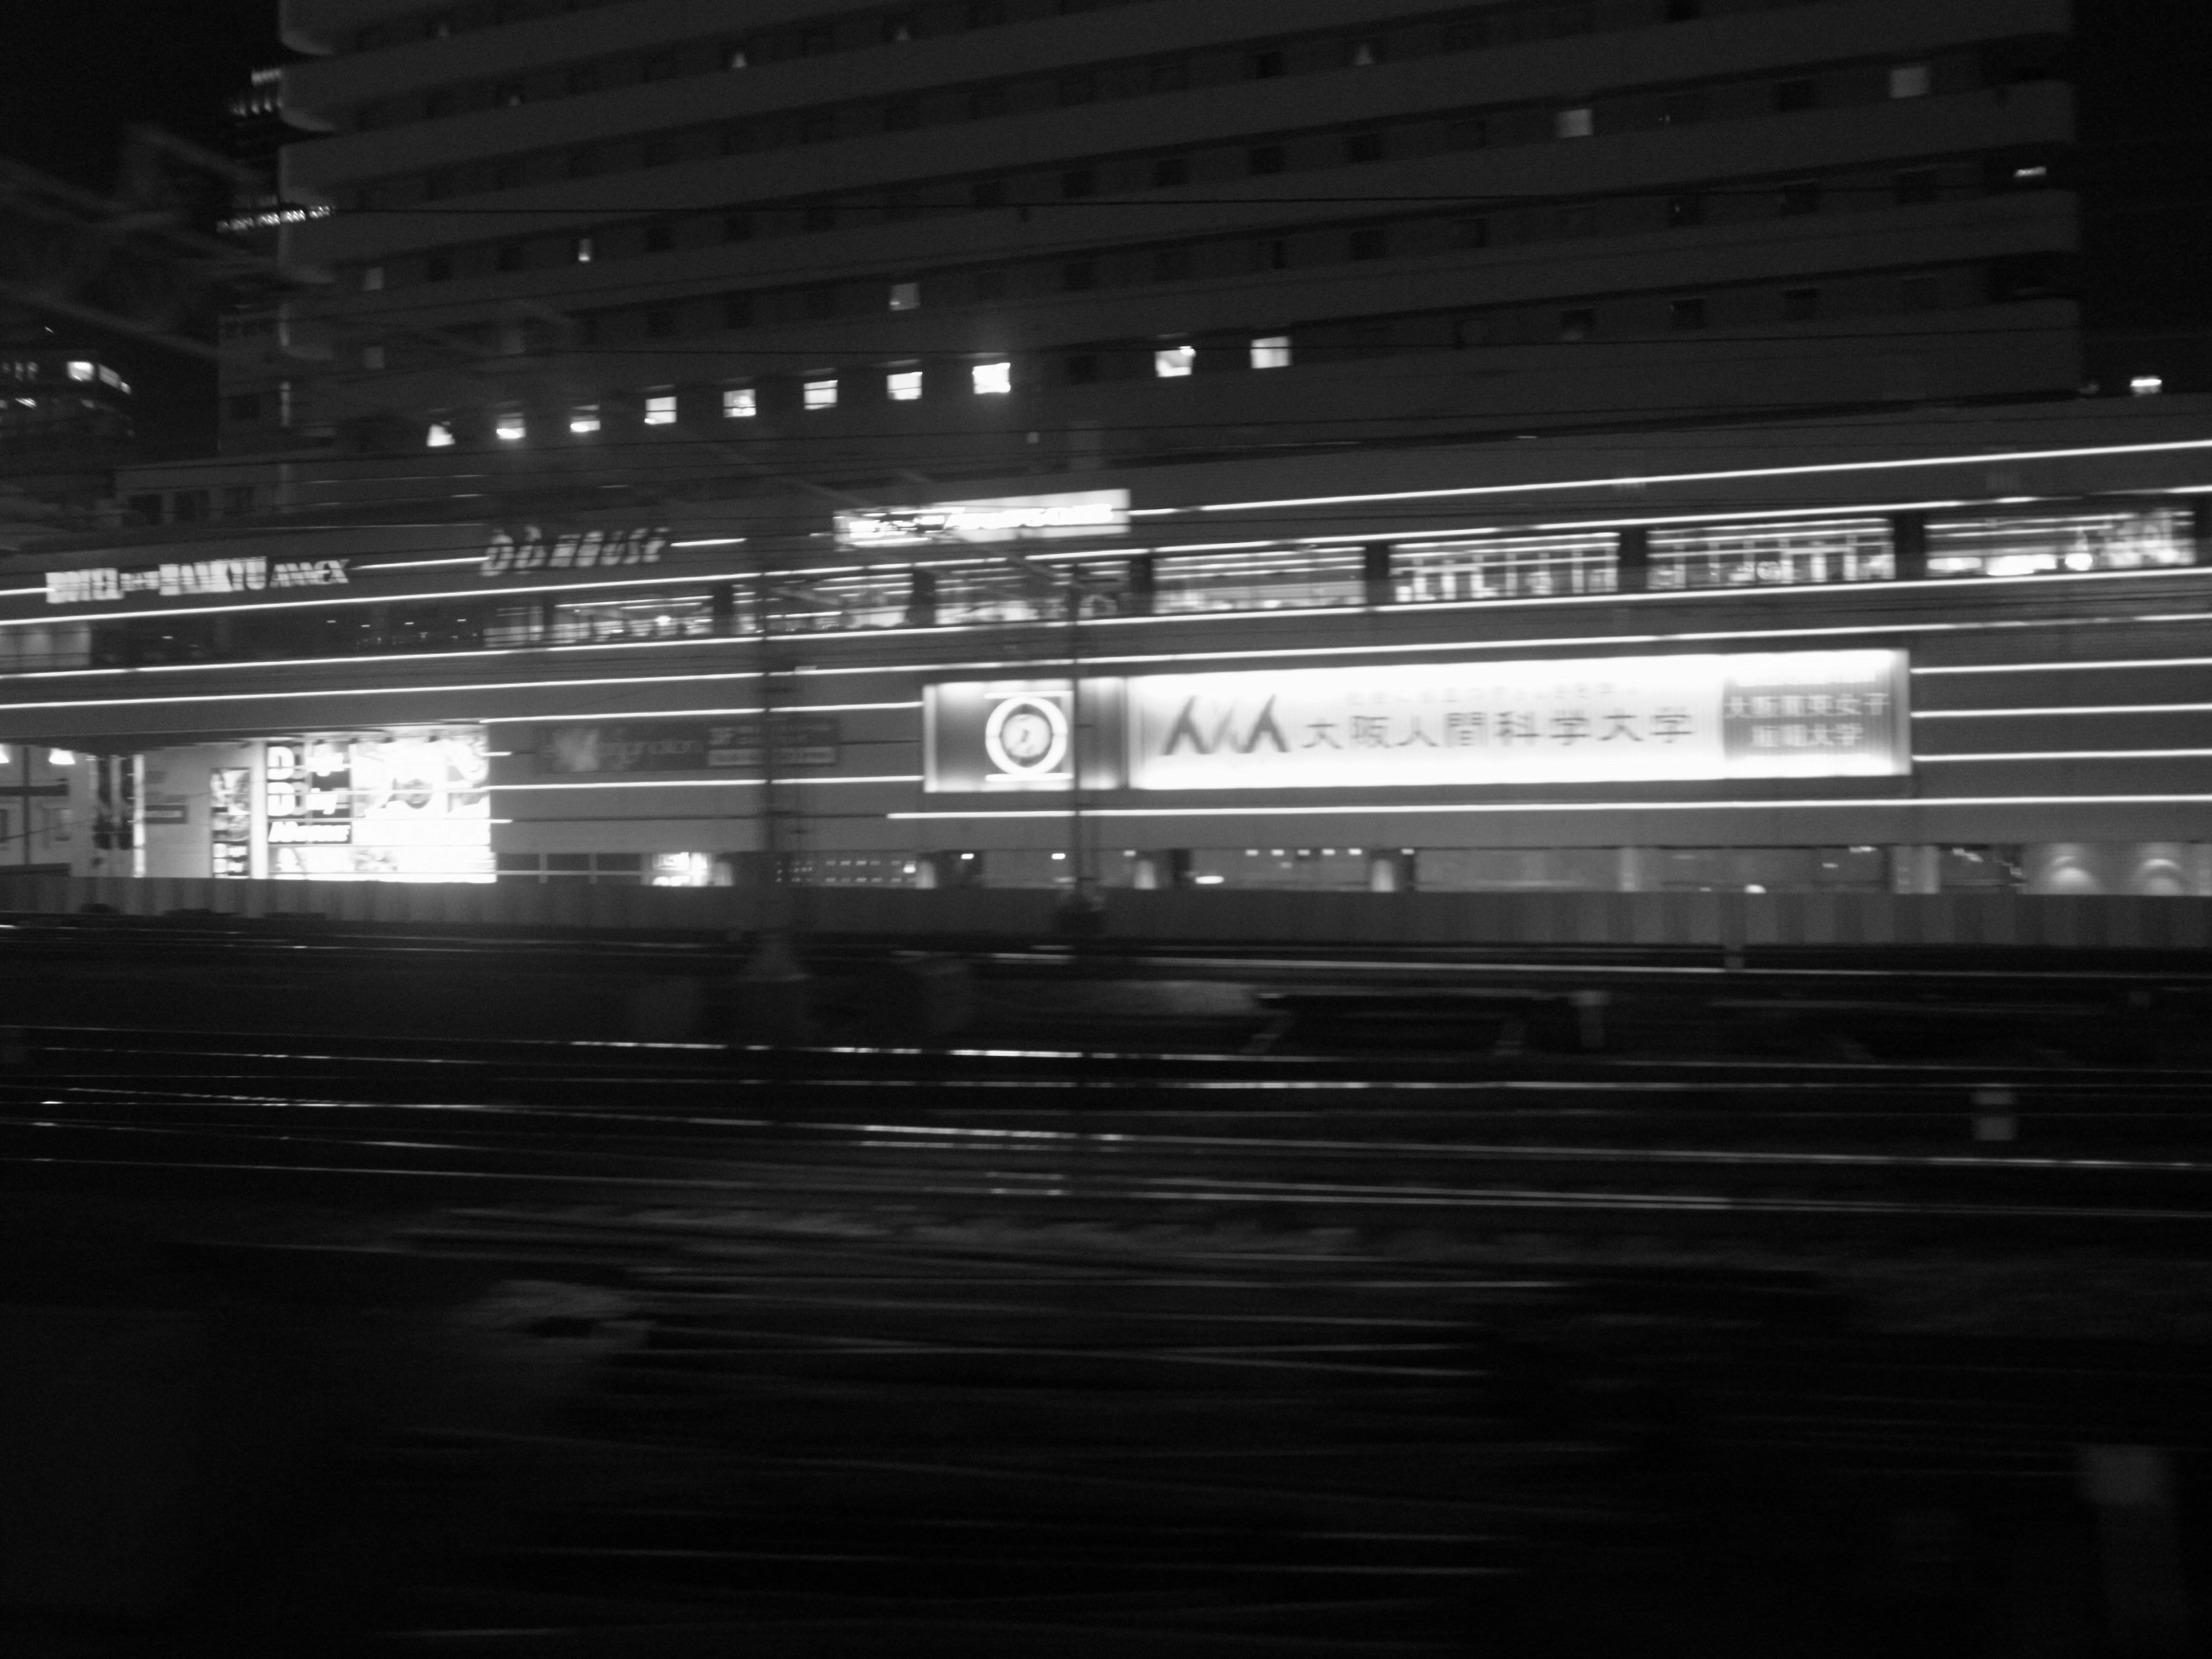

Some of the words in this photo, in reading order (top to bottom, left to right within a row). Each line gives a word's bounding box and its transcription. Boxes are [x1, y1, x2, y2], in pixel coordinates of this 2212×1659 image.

[1300, 706, 1695, 750] 大阪人間科学大学
